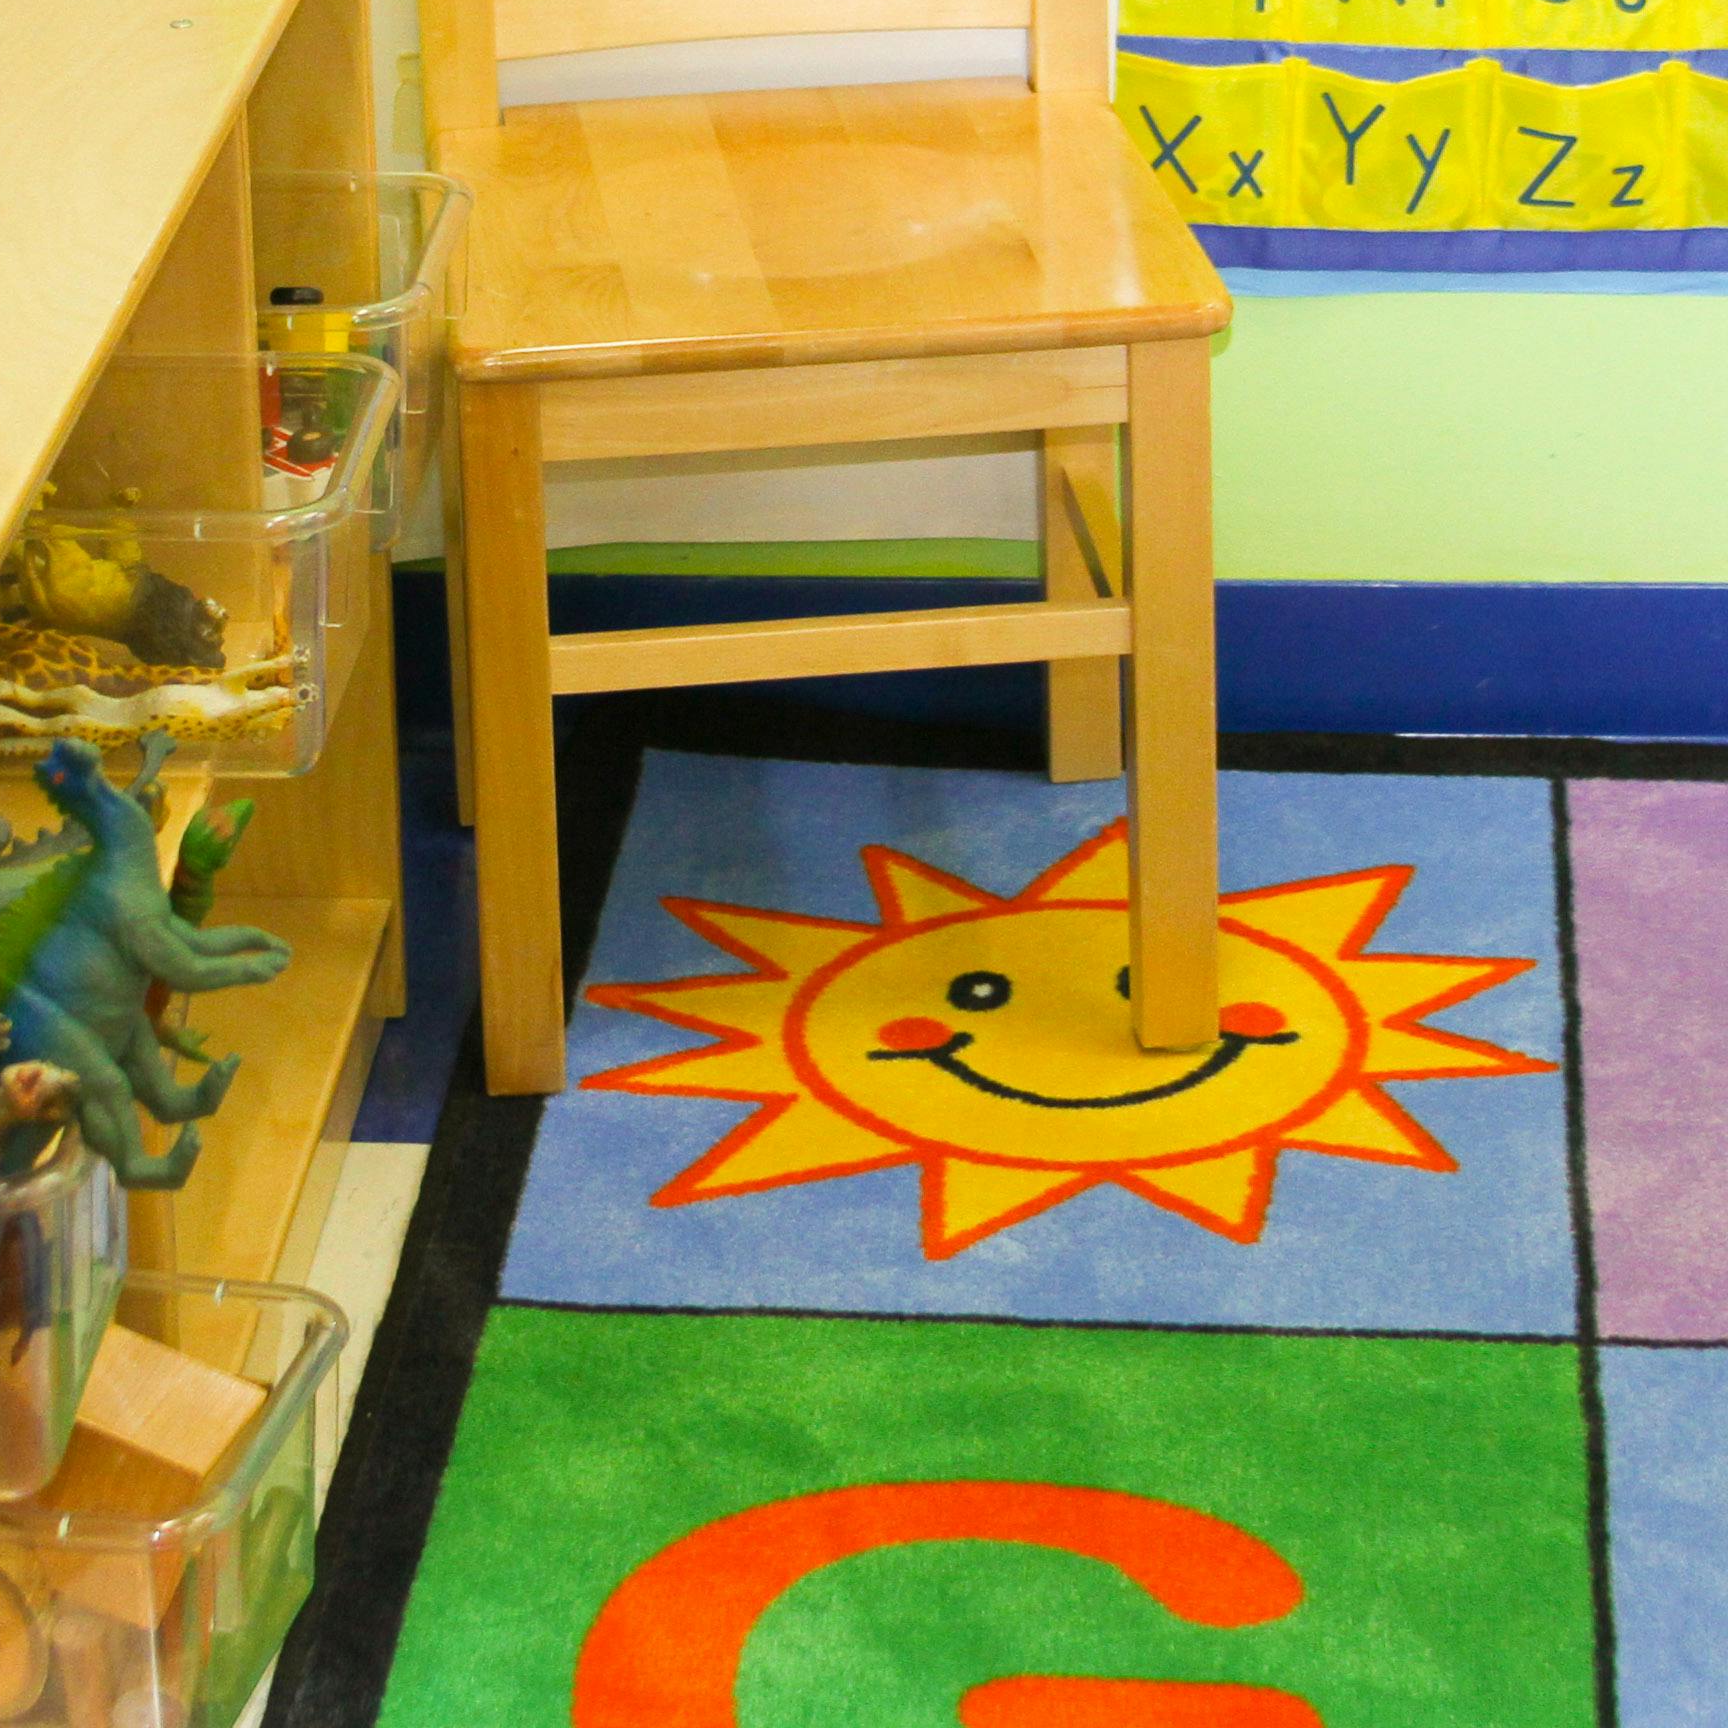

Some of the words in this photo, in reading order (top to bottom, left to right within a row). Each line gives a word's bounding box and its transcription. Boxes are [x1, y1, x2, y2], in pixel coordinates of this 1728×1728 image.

[1139, 105, 1263, 198] Xx
[1322, 92, 1451, 213] Yy
[1518, 126, 1645, 209] Zz
